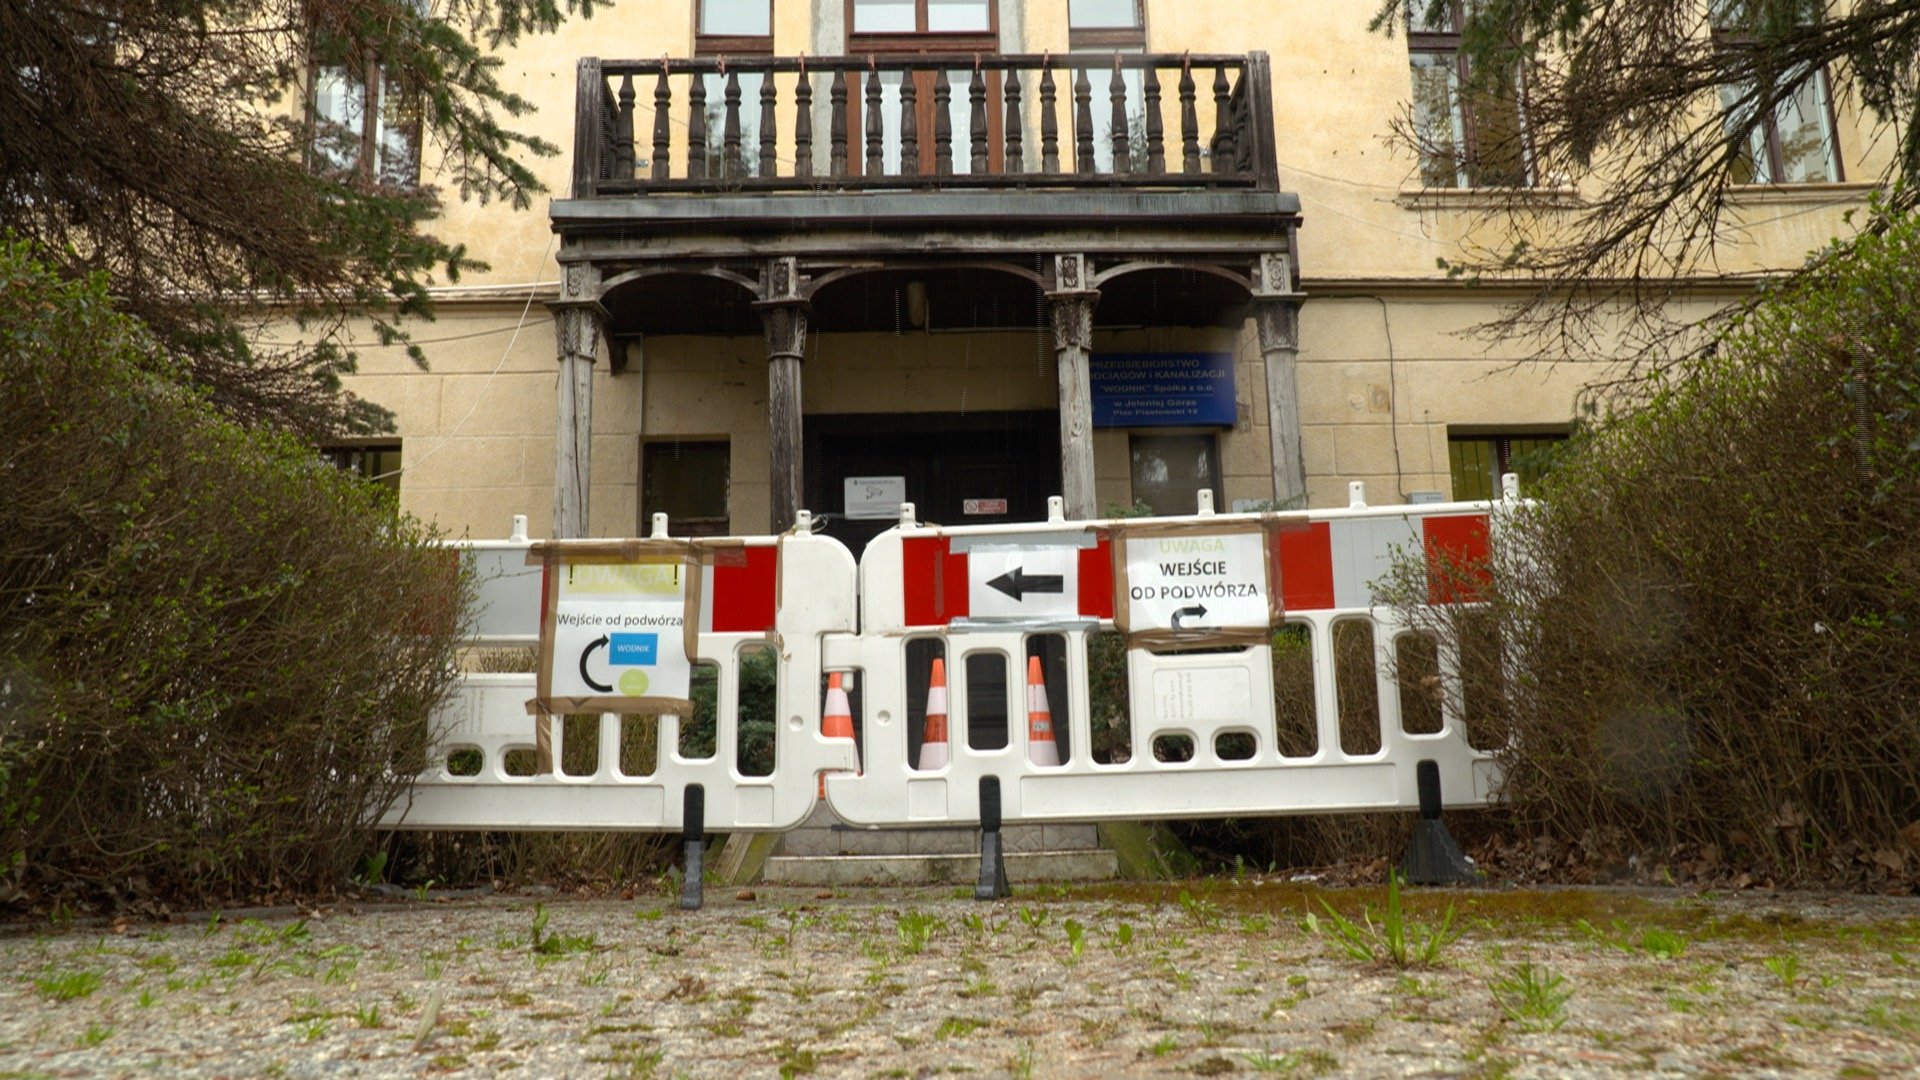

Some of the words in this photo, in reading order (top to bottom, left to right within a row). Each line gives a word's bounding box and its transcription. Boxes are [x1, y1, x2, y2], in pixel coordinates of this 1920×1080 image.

[1155, 369, 1225, 379] KANALIZACJI
[1100, 384, 1151, 393] "WODNIK"
[1153, 384, 1187, 394] Spółka
[1125, 399, 1164, 409] Jeleniej
[1167, 398, 1198, 407] Górze
[1159, 538, 1225, 554] UWAGA
[1159, 558, 1227, 577] WEJŚCIE
[1131, 586, 1155, 600] OD
[1161, 582, 1259, 600] PODWÓRZA
[557, 613, 603, 628] Wejście
[605, 614, 621, 626] od
[624, 614, 683, 629] podwórza
[617, 644, 650, 653] WODNIK
